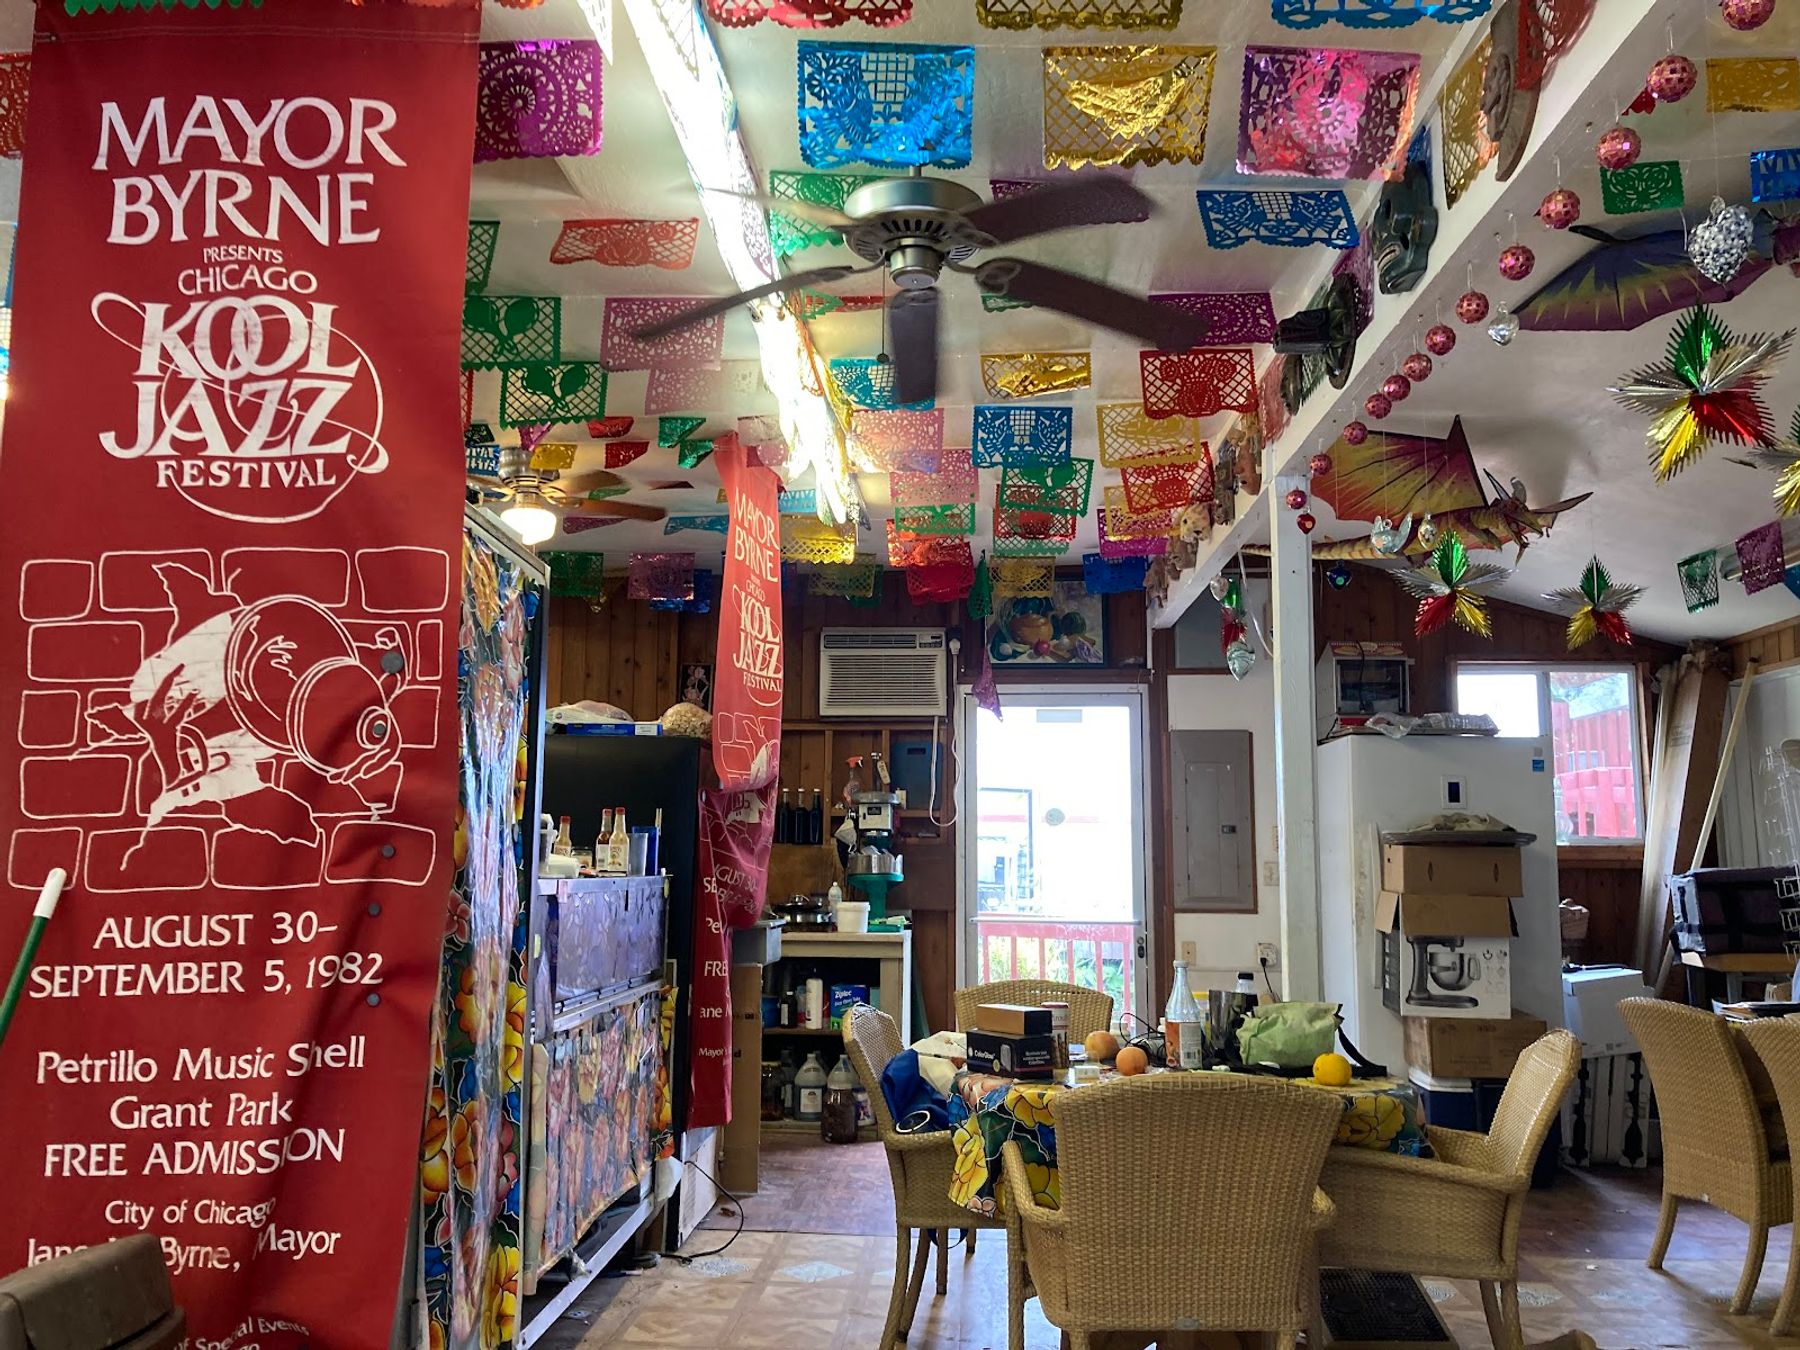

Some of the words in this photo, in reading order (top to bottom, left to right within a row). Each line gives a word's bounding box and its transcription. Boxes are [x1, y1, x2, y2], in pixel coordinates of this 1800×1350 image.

[91, 95, 407, 169] MAYOR
[107, 169, 380, 246] BYRNE
[203, 245, 283, 264] PRESENTS
[178, 265, 317, 295] CHICAGO
[133, 296, 361, 380] KOOL
[99, 378, 353, 459] JAZZ
[156, 458, 336, 488] FESTIVAL
[734, 486, 780, 550] MAYOR
[735, 525, 778, 582] BYRNE
[740, 591, 780, 643] KOOL
[733, 632, 783, 679] JAZZ
[743, 671, 782, 692] FESTIVAL
[93, 914, 253, 949] AUGUST
[29, 961, 245, 998] SEPTEMBER
[263, 960, 292, 995] 5,
[306, 952, 384, 988] 1982
[704, 960, 728, 977] FRE
[700, 1006, 723, 1018] ane
[37, 1049, 158, 1084] Petrillo
[173, 1046, 275, 1081] Music
[286, 1035, 366, 1077] Shell
[110, 1096, 212, 1129] Grant
[226, 1092, 293, 1127] Park
[44, 1143, 127, 1177] FREE
[142, 1128, 345, 1176] ADMISSION
[105, 1199, 154, 1229] City
[163, 1200, 188, 1224] of
[193, 1197, 276, 1229] Chicago
[160, 1236, 241, 1275] Byrne,
[252, 1223, 341, 1260] Mayor
